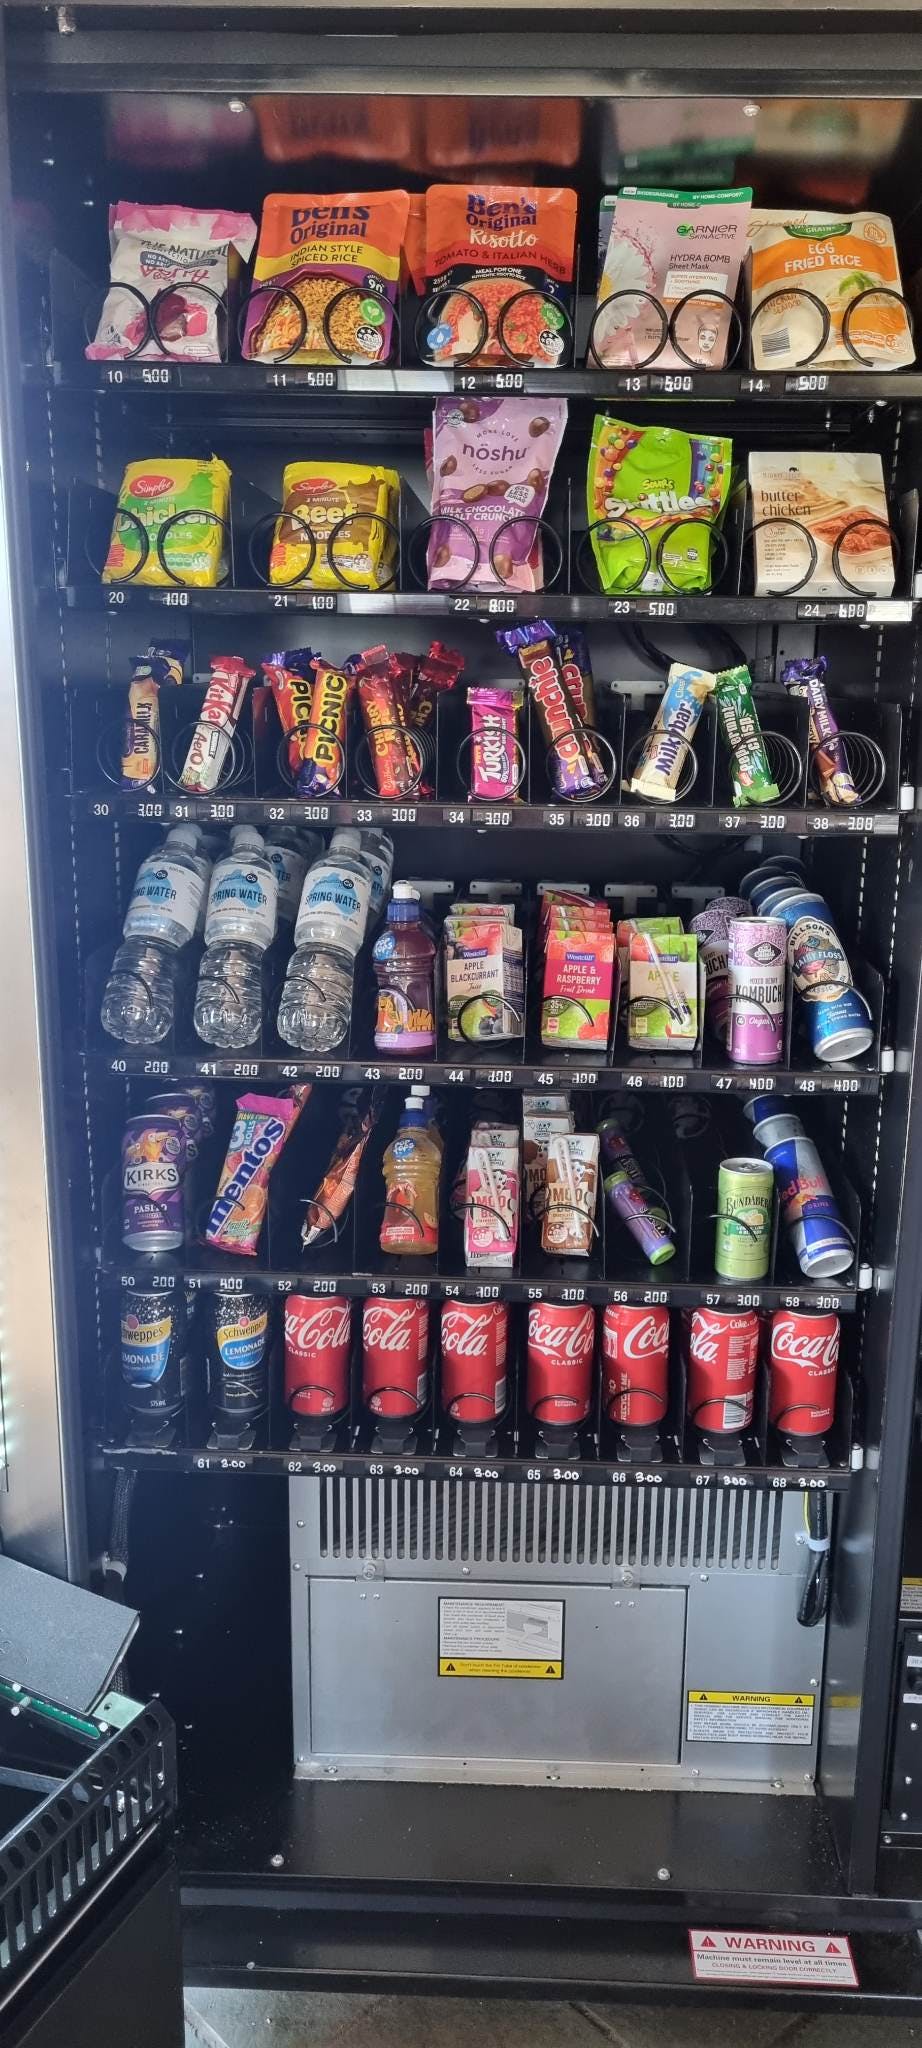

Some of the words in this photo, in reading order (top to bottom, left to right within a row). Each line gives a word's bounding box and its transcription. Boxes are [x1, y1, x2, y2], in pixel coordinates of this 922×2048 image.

[467, 194, 537, 215] Ben's
[466, 214, 537, 231] Original
[290, 221, 367, 245] Original
[676, 224, 738, 236] GARNIER
[470, 229, 538, 249] Risotto
[290, 244, 327, 262] INDIAN
[330, 244, 364, 254] STYLE
[808, 242, 836, 255] EGG
[289, 253, 329, 268] SPICED
[332, 253, 359, 263] RICE
[434, 249, 479, 267] TOMATO
[482, 250, 490, 259] &
[492, 250, 537, 260] ITALIAN
[540, 255, 566, 275] HERB
[670, 254, 702, 262] HYDRA
[703, 254, 731, 264] BOMB
[784, 256, 825, 274] FRIED
[829, 254, 864, 267] RICE
[668, 262, 689, 270] Sheet
[690, 262, 710, 270] Mask
[108, 371, 122, 382] 10
[143, 369, 168, 382] 5.00
[274, 374, 286, 386] 11
[308, 373, 333, 386] 5.00
[461, 377, 475, 389] 12
[626, 378, 640, 390] 13
[749, 380, 763, 391] 14
[476, 429, 497, 438] MORE
[501, 431, 519, 442] LOVE
[462, 443, 528, 461] nöshu
[490, 465, 513, 475] SUGAR
[642, 479, 675, 491] SOURS
[761, 490, 801, 502] butter
[604, 490, 714, 518] Skittles
[441, 506, 464, 515] MILK
[465, 505, 526, 517] CHOCOLATE
[762, 503, 812, 517] chicken
[291, 504, 359, 531] Beef
[110, 592, 124, 603] 20
[274, 595, 287, 606] 21
[455, 599, 469, 610] 22
[615, 601, 629, 613] 23
[649, 602, 674, 615] 5.00
[803, 605, 821, 616] 24
[809, 679, 826, 710] DAIRY
[529, 656, 581, 761] Crunchie
[315, 674, 345, 761] PICNIC
[816, 708, 833, 738] MILK
[654, 702, 692, 776] Milkybar
[478, 714, 506, 783] TURKISH
[94, 804, 108, 815] 30
[175, 806, 188, 817] 31
[211, 805, 233, 817] 3.00
[270, 808, 284, 819] 32
[305, 807, 328, 819] 3.00
[357, 810, 372, 821] 33
[449, 812, 464, 823] 34
[550, 814, 564, 825] 35
[625, 815, 639, 826] 36
[725, 816, 740, 827] 37
[814, 818, 830, 829] 38
[146, 886, 177, 900] WATER
[210, 888, 236, 904] SPRING
[239, 887, 268, 905] WATER
[305, 891, 332, 905] SPRING
[334, 893, 362, 912] WATER
[463, 950, 487, 958] Westcliff
[566, 953, 595, 961] Westcliff
[817, 951, 842, 959] FLOSS
[464, 960, 484, 971] APPLE
[563, 964, 588, 974] APPLE
[590, 965, 596, 974] &
[450, 969, 499, 983] BLACKCURRANT
[556, 974, 601, 985] RASPBERRY
[560, 985, 575, 993] Fruit
[576, 985, 596, 995] Drink
[112, 1060, 126, 1071] 40
[145, 1061, 168, 1073] 2.00
[201, 1063, 216, 1074] 41
[234, 1064, 257, 1078] 2.00
[283, 1066, 297, 1077] 42
[316, 1066, 339, 1077] 2.00
[365, 1068, 380, 1079] 43
[399, 1068, 422, 1079] 2.00
[449, 1071, 463, 1081] 44
[539, 1073, 553, 1084] 45
[627, 1076, 642, 1087] 46
[717, 1078, 732, 1089] 47
[800, 1080, 815, 1091] 48
[229, 1120, 247, 1149] 3
[243, 1120, 256, 1145] ROLLS
[127, 1168, 177, 1186] KIRKS
[206, 1117, 285, 1237] mentos
[800, 1175, 827, 1191] Bull
[122, 1277, 134, 1285] 50
[153, 1276, 174, 1287] 2.00
[189, 1279, 200, 1288] 51
[278, 1281, 291, 1290] 52
[314, 1280, 336, 1292] 2.00
[372, 1283, 385, 1293] 53
[406, 1284, 427, 1294] 2.00
[446, 1286, 458, 1295] 54
[529, 1288, 542, 1298] 55
[614, 1291, 627, 1301] 56
[707, 1294, 720, 1304] 57
[738, 1295, 759, 1306] 3.00
[786, 1297, 799, 1306] 58
[223, 1320, 265, 1340] Schweppes
[225, 1337, 266, 1355] LEMONADE
[288, 1346, 317, 1358] CLASSIC
[808, 1366, 836, 1376] CLASSIC
[621, 1373, 628, 1386] ME
[198, 1458, 209, 1468] 61
[221, 1459, 245, 1468] 3.00
[289, 1462, 301, 1471] 62
[313, 1462, 336, 1472] 3.00
[370, 1464, 383, 1474] 63
[394, 1465, 418, 1474] 3.00
[450, 1467, 462, 1476] 64
[474, 1468, 498, 1478] 3.00
[528, 1469, 540, 1480] 65
[553, 1469, 579, 1480] 3.00
[613, 1472, 625, 1482] 66
[636, 1472, 662, 1482] 3.00
[696, 1475, 709, 1485] 67
[773, 1477, 786, 1487] 68
[798, 1478, 825, 1487] 3.00
[732, 1695, 771, 1703] WARNING
[724, 1936, 816, 1953] WARNING
[697, 1952, 730, 1962] Machine
[783, 1957, 802, 1965] level
